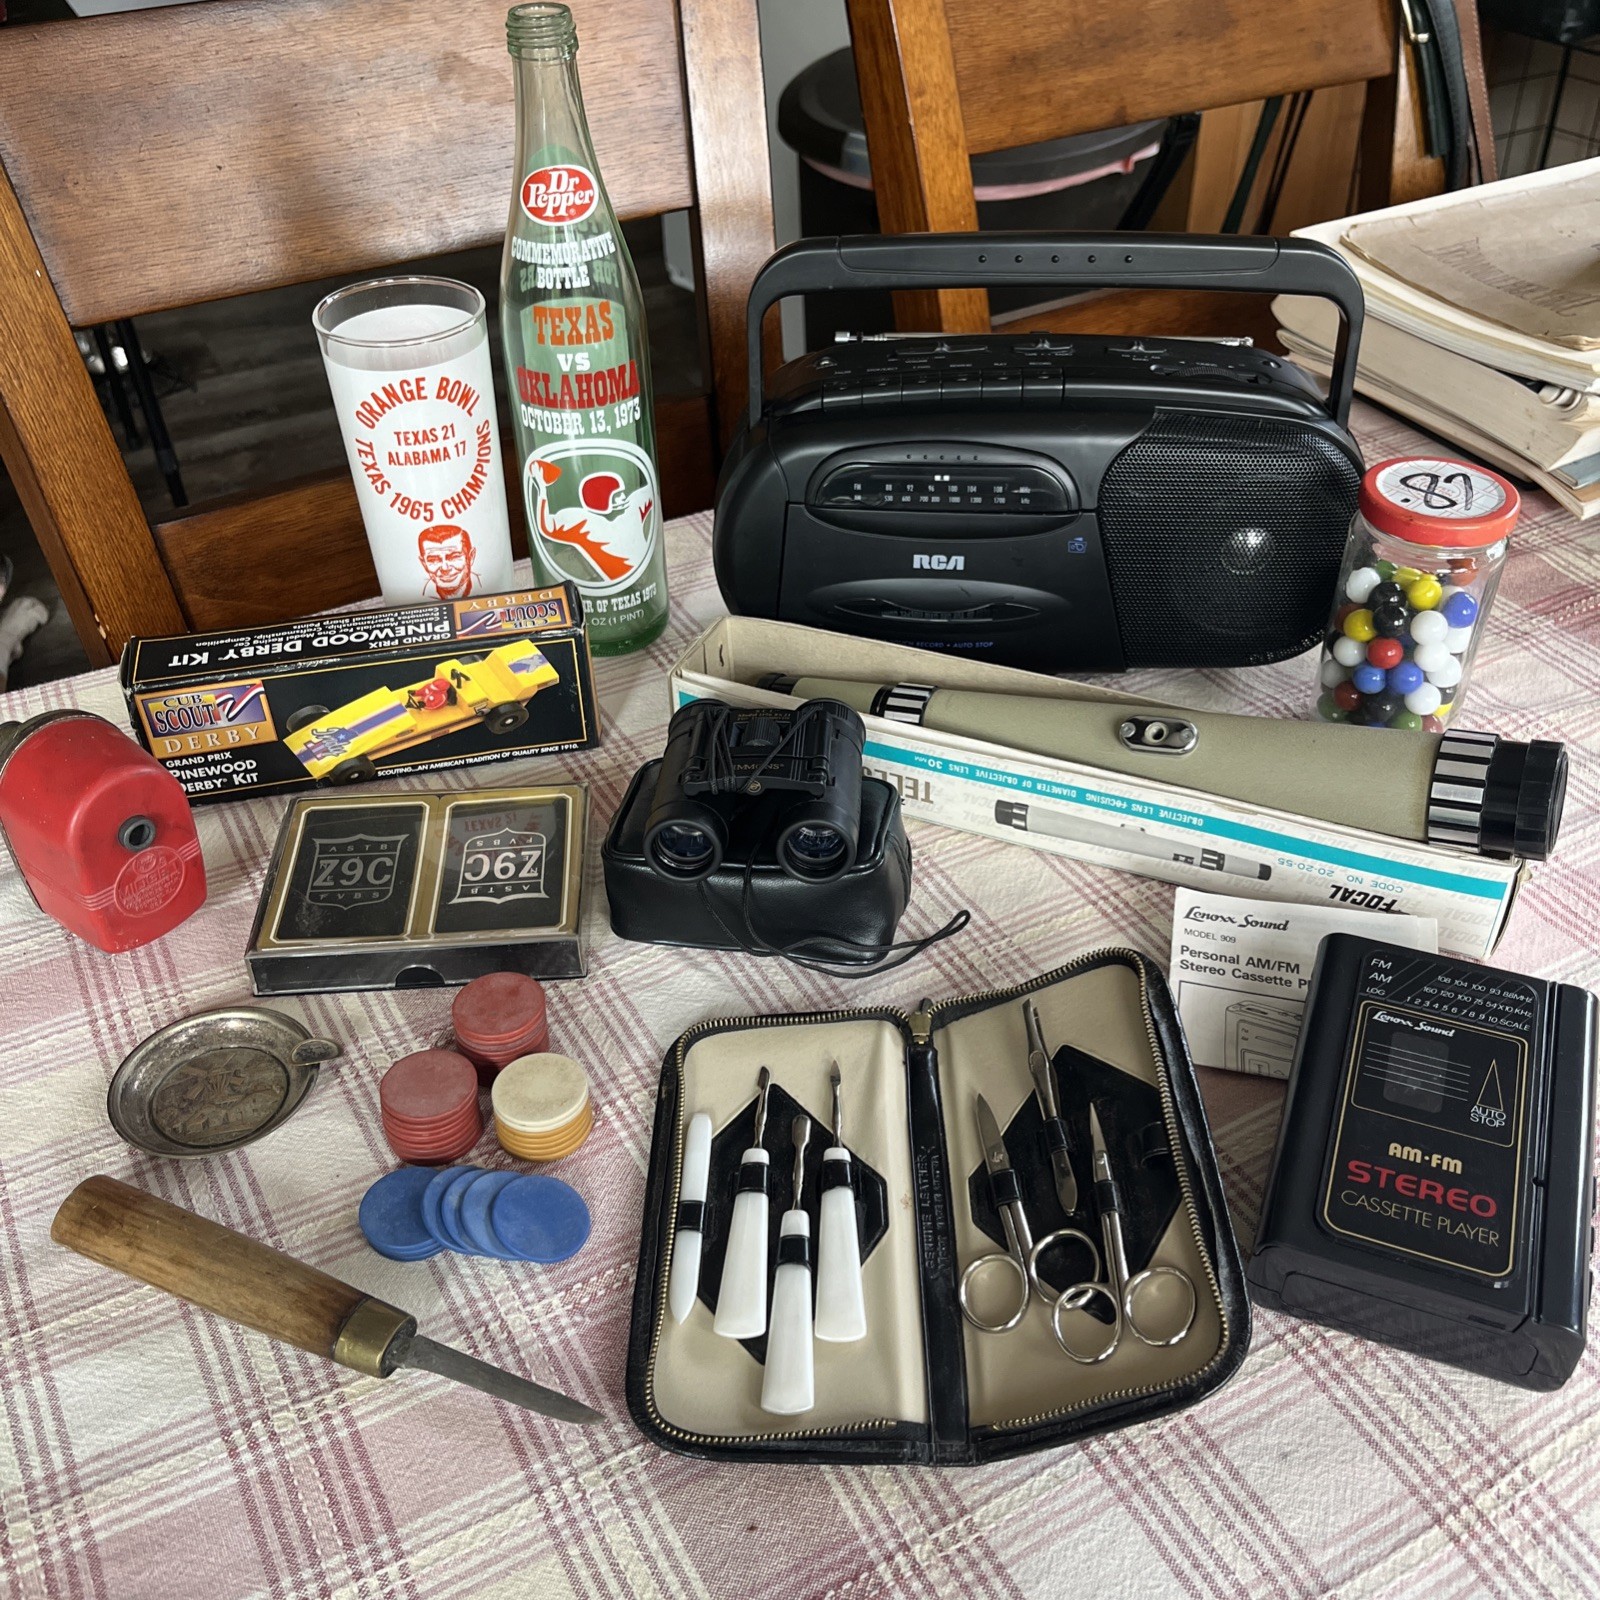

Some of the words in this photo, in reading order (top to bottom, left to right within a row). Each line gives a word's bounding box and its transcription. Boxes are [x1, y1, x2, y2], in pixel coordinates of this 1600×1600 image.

[548, 171, 579, 193] Dr
[526, 183, 594, 217] Pepper
[511, 231, 616, 266] COMMEMORATIVE
[536, 264, 590, 290] BOTTLE
[533, 299, 614, 346] TEXAS
[516, 359, 640, 409] OKLAHOMA
[355, 377, 427, 430] ORANGE
[436, 376, 480, 417] BOWL
[521, 404, 584, 435] OCTOBER
[589, 411, 611, 434] 13,
[614, 397, 641, 429] 1973
[394, 428, 438, 446] TEXAS
[441, 423, 456, 440] 21
[388, 446, 451, 466] ALABAMA
[454, 440, 467, 457] 17
[355, 438, 391, 495] TEXAS
[390, 492, 434, 522] 1965
[441, 419, 491, 519] CHAMPIONS
[913, 555, 964, 570] RCA
[469, 591, 553, 610] DERBY
[596, 599, 608, 613] OF
[611, 591, 641, 611] TEXAS
[401, 607, 439, 615] Contains
[402, 617, 439, 625] Contains
[506, 602, 557, 622] SCOUT
[591, 618, 606, 626] OZ
[620, 609, 644, 623] PINT)
[356, 621, 398, 631] Materials
[514, 619, 549, 628] CUB
[312, 621, 450, 647] PINEWOOD
[403, 633, 451, 644] GRAND
[223, 640, 302, 660] DERBY
[369, 640, 398, 649] PRIX
[168, 652, 209, 667] KIT
[163, 694, 204, 708] CUB
[155, 703, 214, 733] SCOUT
[164, 726, 259, 753] DERBY
[166, 756, 205, 768] GRAND
[208, 752, 232, 761] PRIX
[430, 760, 464, 770] AMERICAN
[466, 754, 500, 764] TRADITION
[512, 748, 539, 757] QUALITY
[948, 764, 970, 774] LENS
[169, 760, 257, 780] PINEWOOD
[232, 772, 258, 785] KIT
[975, 769, 1018, 785] OBJECTIVE
[1022, 780, 1032, 788] OF
[1036, 783, 1076, 798] DIAMETER
[1086, 793, 1128, 808] FOCUSING
[1131, 804, 1153, 814] LENS
[1158, 809, 1204, 826] OBJECTIVE
[312, 857, 394, 886] Z9C
[1346, 875, 1364, 884] NO
[1370, 880, 1403, 894] CODE
[1329, 884, 1398, 914] FOCAL
[1184, 906, 1237, 923] Lenoxx
[1238, 914, 1290, 931] Sound
[1184, 928, 1217, 940] MODEL
[1220, 934, 1236, 944] 909
[1180, 945, 1240, 966] Personal
[1246, 957, 1300, 974] AM/FM
[1180, 960, 1226, 976] Stereo
[1232, 968, 1292, 988] Cassette
[1370, 958, 1392, 970] FM
[1437, 976, 1452, 984] 108
[1454, 980, 1468, 988] 104
[1472, 984, 1486, 992] 100
[1489, 988, 1500, 996] 93
[1368, 972, 1392, 984] AM
[1423, 986, 1438, 994] 160
[1440, 990, 1454, 998] 120
[1457, 994, 1472, 1002] 100
[1474, 998, 1484, 1006] 75
[1366, 986, 1386, 996] LOG
[1488, 1016, 1498, 1024] 10
[1499, 1018, 1530, 1032] SCALE
[1414, 1022, 1456, 1037] Sound
[1470, 1104, 1507, 1121] AUTO
[1470, 1114, 1506, 1128] STOP
[1347, 1160, 1498, 1218] STEREO
[1341, 1190, 1432, 1228] CASSETTE
[1437, 1216, 1499, 1247] PLAYER
